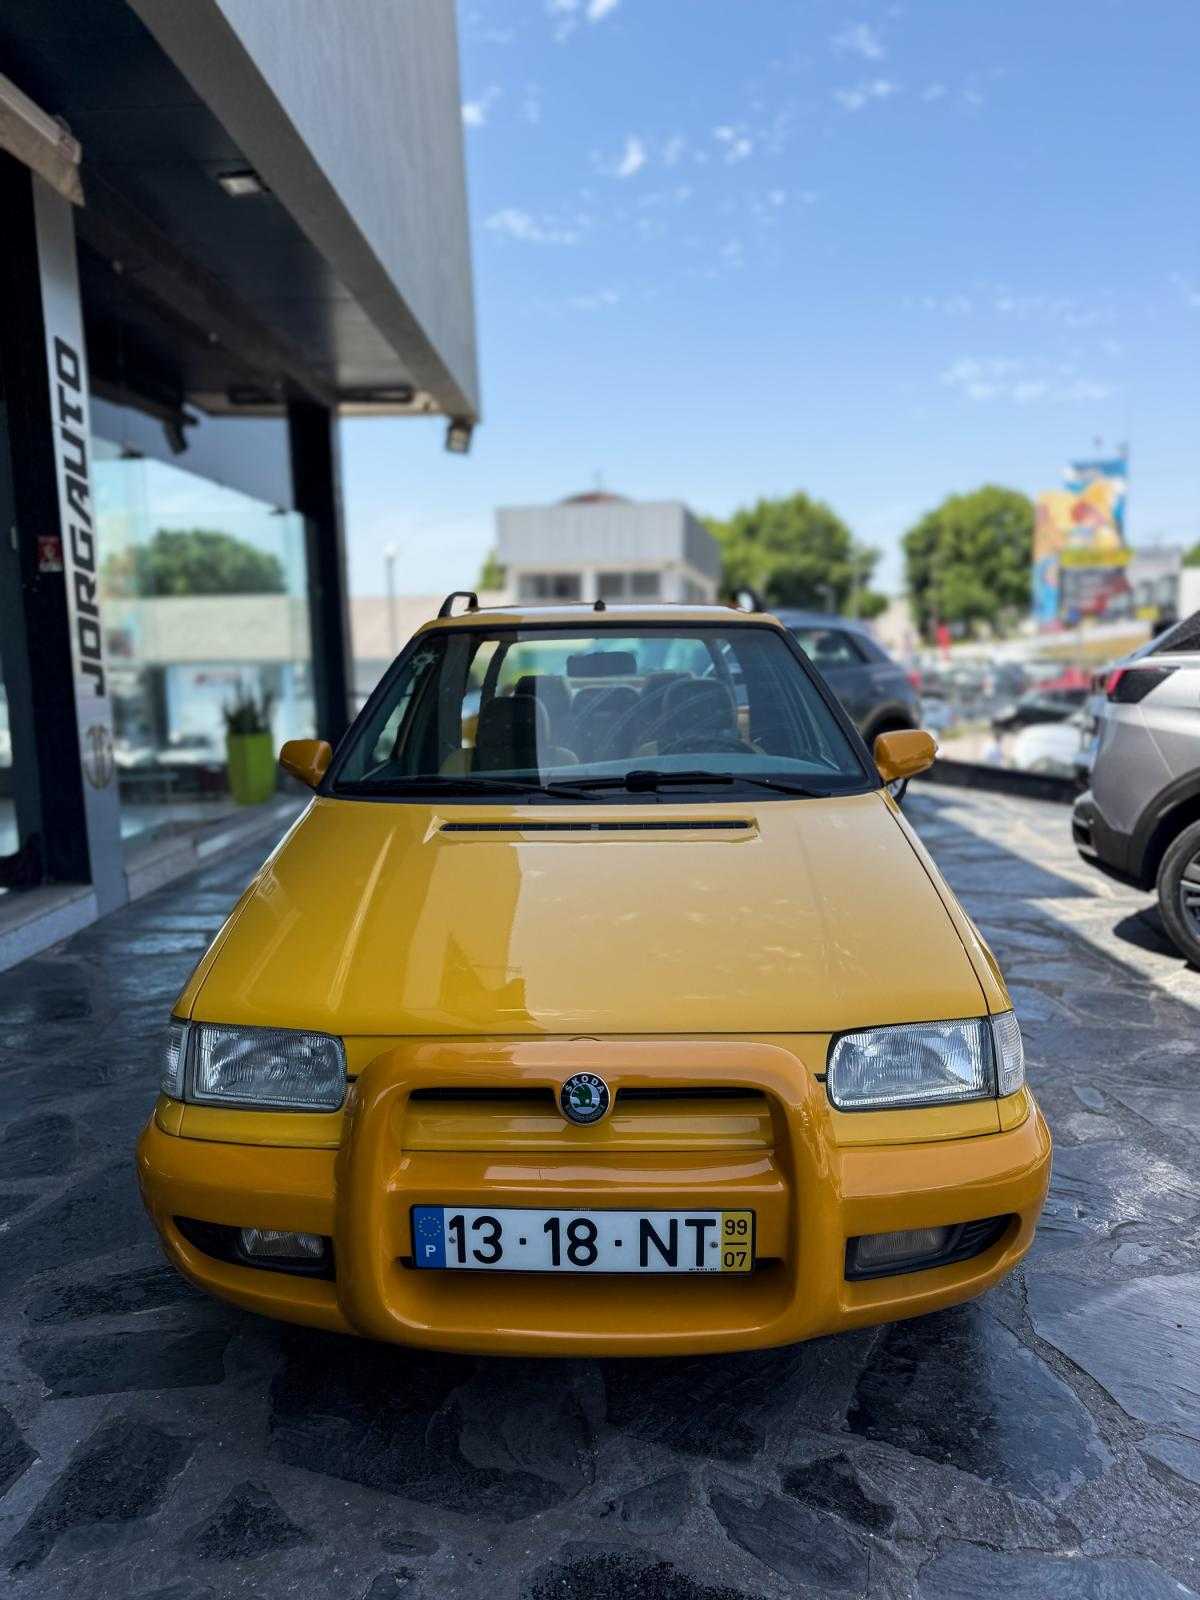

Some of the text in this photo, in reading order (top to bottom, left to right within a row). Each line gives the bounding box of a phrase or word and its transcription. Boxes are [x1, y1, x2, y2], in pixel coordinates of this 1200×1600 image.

[54, 335, 105, 697] JORGAUTO
[724, 1219, 748, 1236] 99
[425, 1245, 436, 1257] P
[723, 1251, 748, 1268] 07
